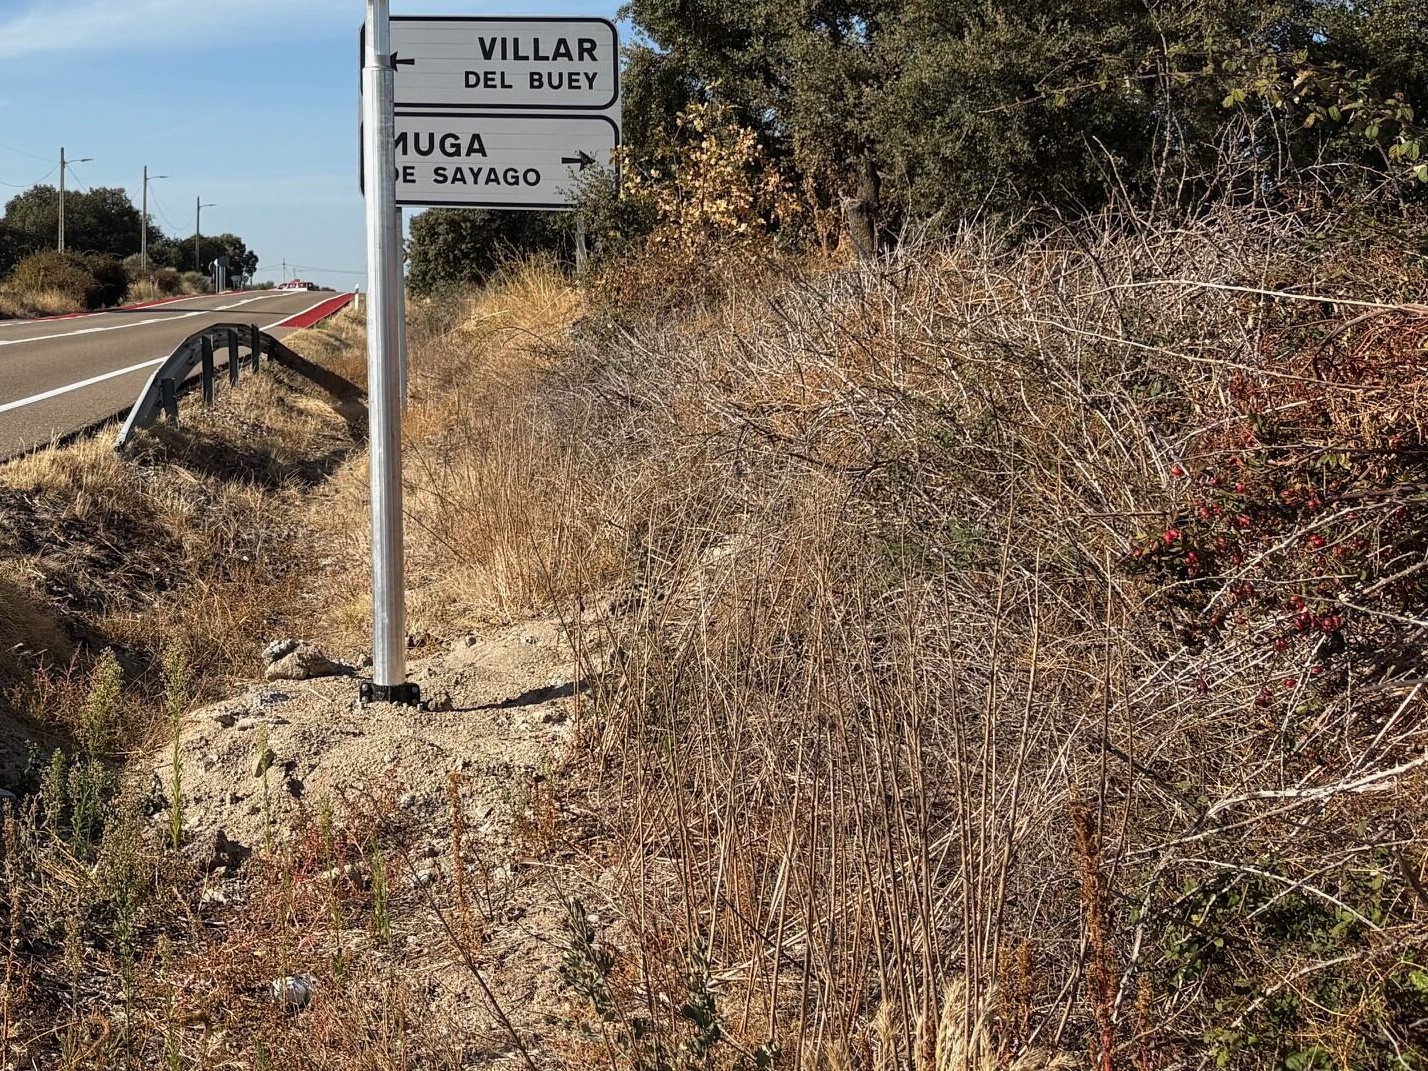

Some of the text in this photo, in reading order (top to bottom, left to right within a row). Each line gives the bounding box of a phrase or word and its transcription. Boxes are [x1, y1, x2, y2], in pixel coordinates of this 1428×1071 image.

[478, 37, 598, 62] VILLAR
[464, 71, 598, 90] DEL BUEY
[395, 166, 541, 186] E SAYAGO
